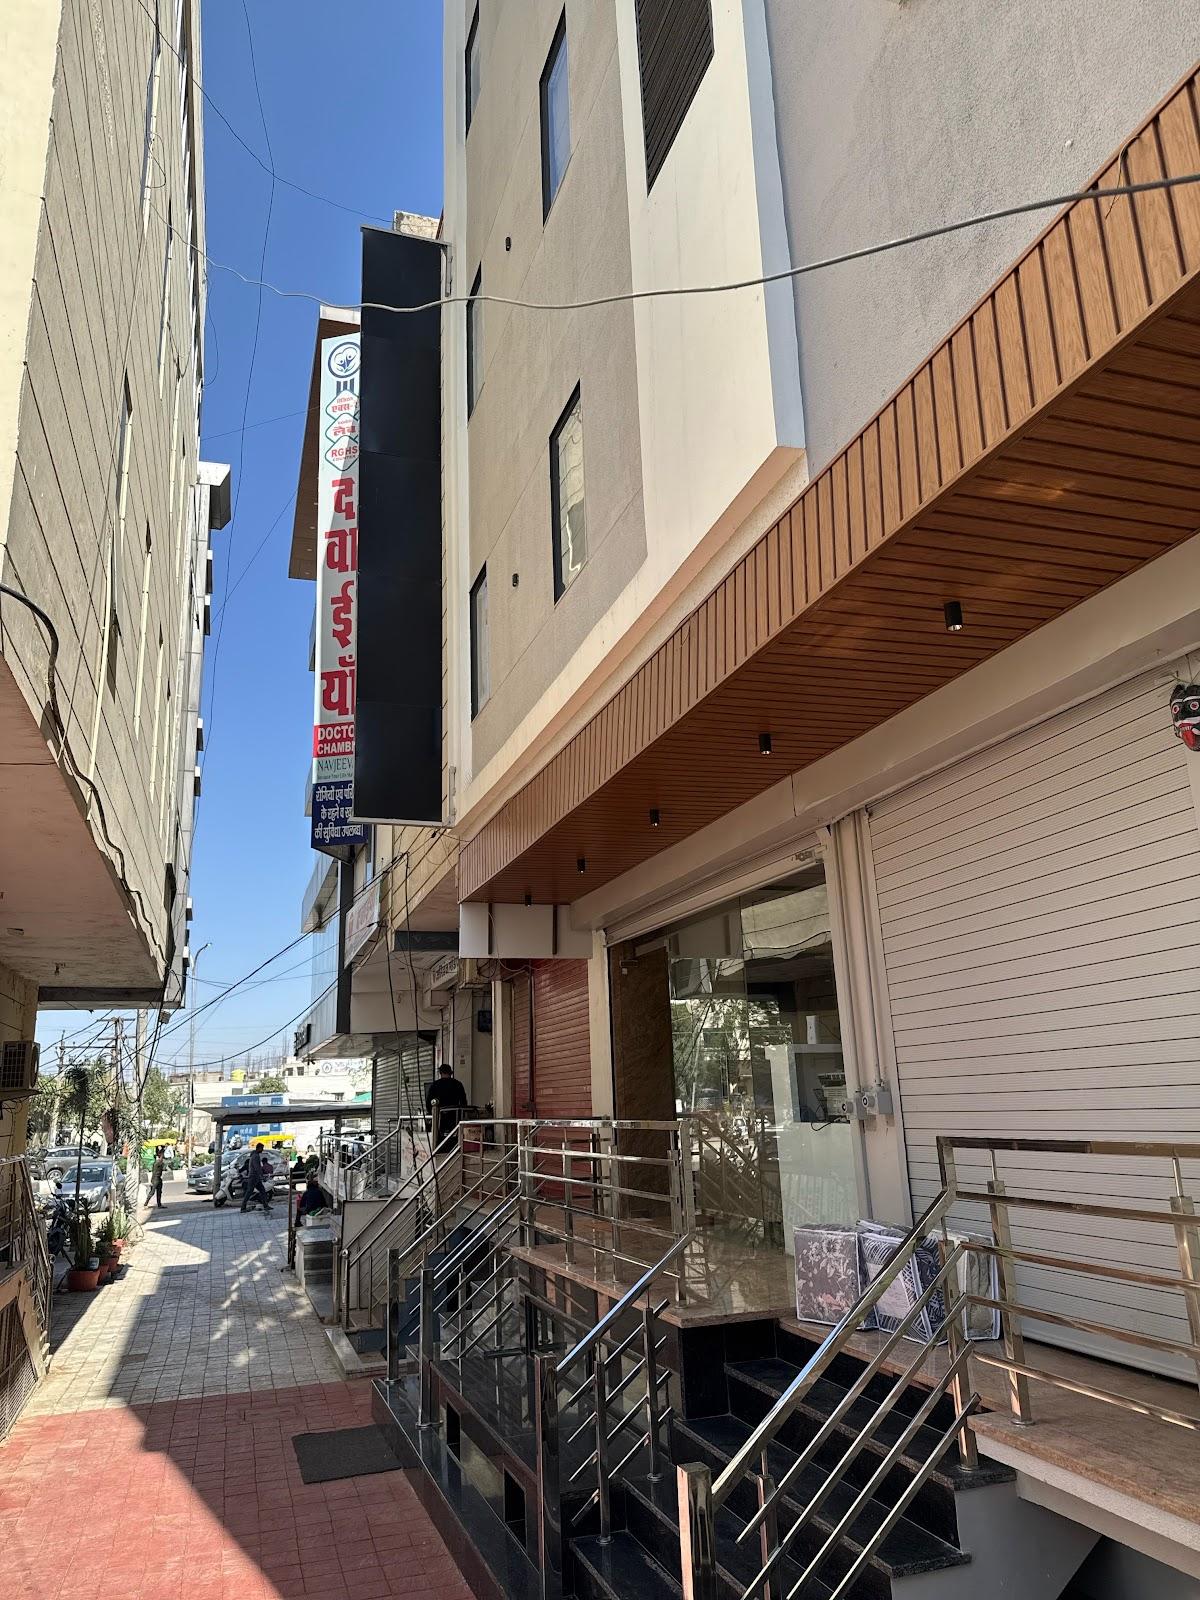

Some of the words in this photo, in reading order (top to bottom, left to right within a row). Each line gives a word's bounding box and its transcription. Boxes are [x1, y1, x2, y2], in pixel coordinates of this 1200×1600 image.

[331, 446, 358, 458] RGHS
[318, 758, 353, 772] NAVJEEV
[314, 823, 323, 839] की
